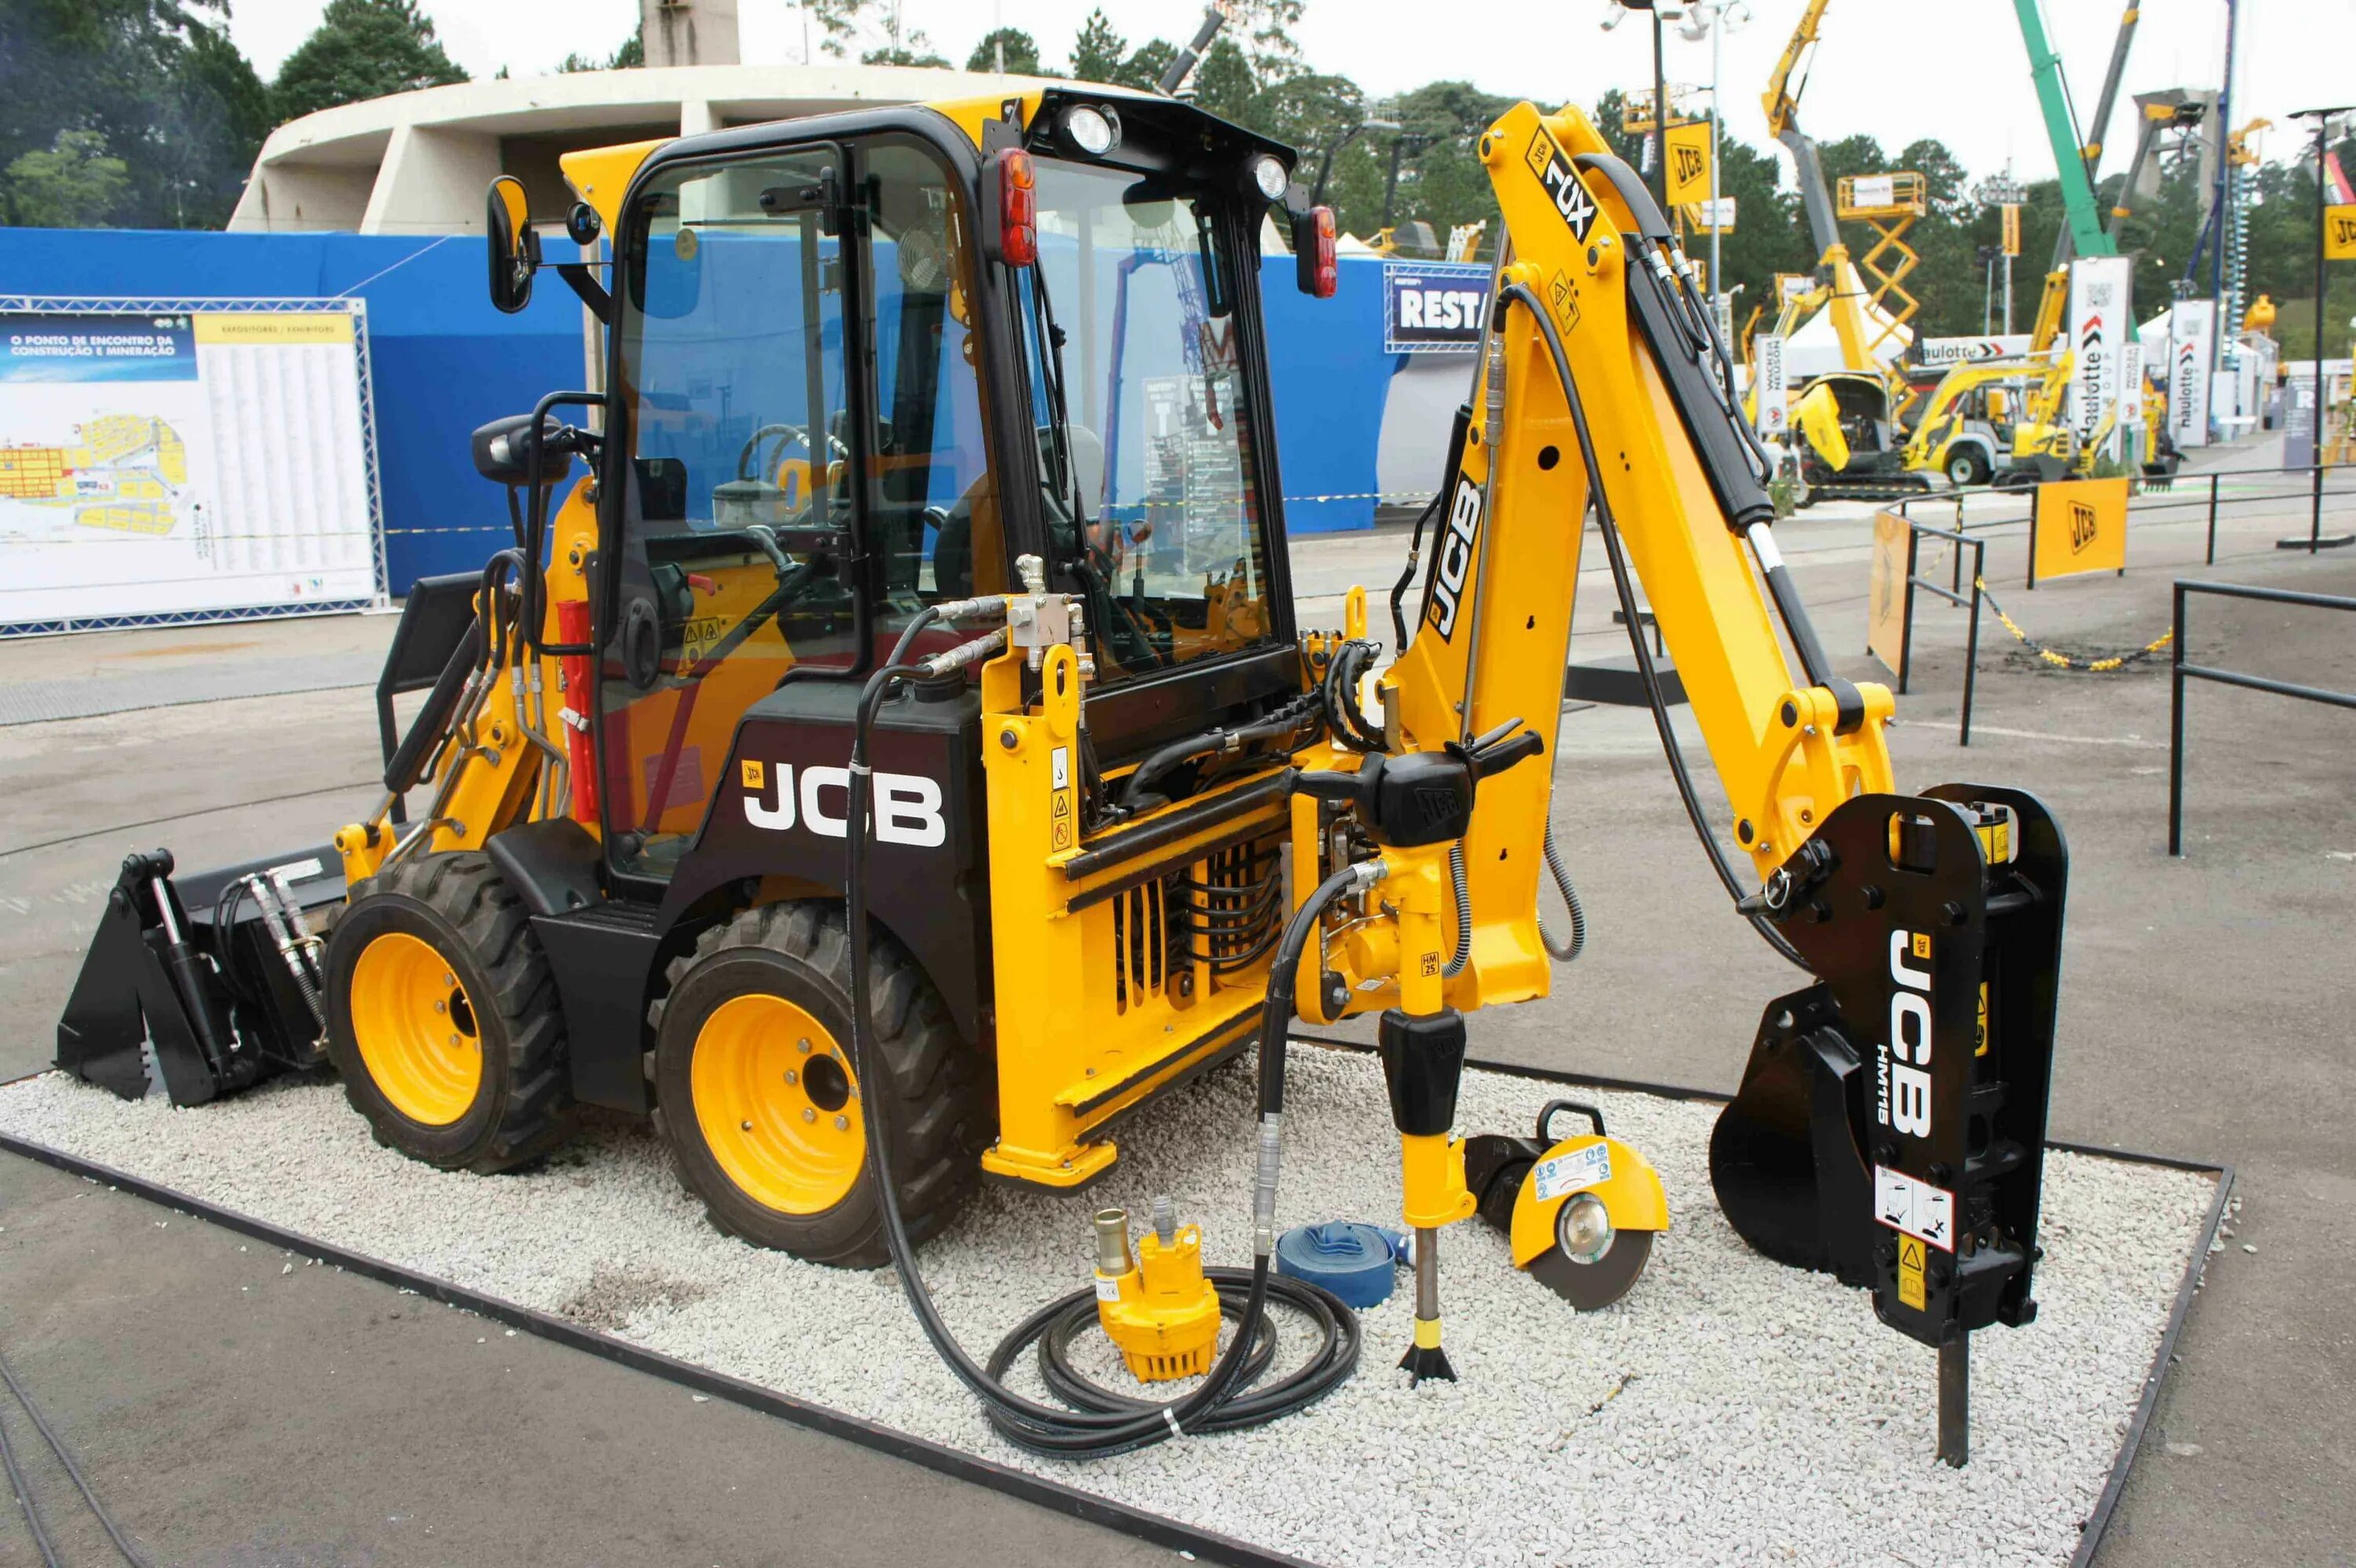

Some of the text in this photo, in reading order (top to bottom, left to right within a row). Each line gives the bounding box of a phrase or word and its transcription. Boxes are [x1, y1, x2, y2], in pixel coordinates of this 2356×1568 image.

[1535, 143, 1548, 163] JCB
[1677, 148, 1702, 183] JCB
[10, 335, 174, 345] O PONTO DE ENCONTRO DA
[11, 344, 176, 357] CONSTRUÇÃO E MINERAÇÃO
[1923, 345, 1977, 359] aulotte
[2072, 506, 2095, 548] JCB
[1436, 480, 1481, 636] JCB
[743, 762, 946, 848] JCB
[1423, 954, 1437, 965] HM
[1425, 964, 1436, 974] 25
[1890, 929, 1931, 1139] JCB
